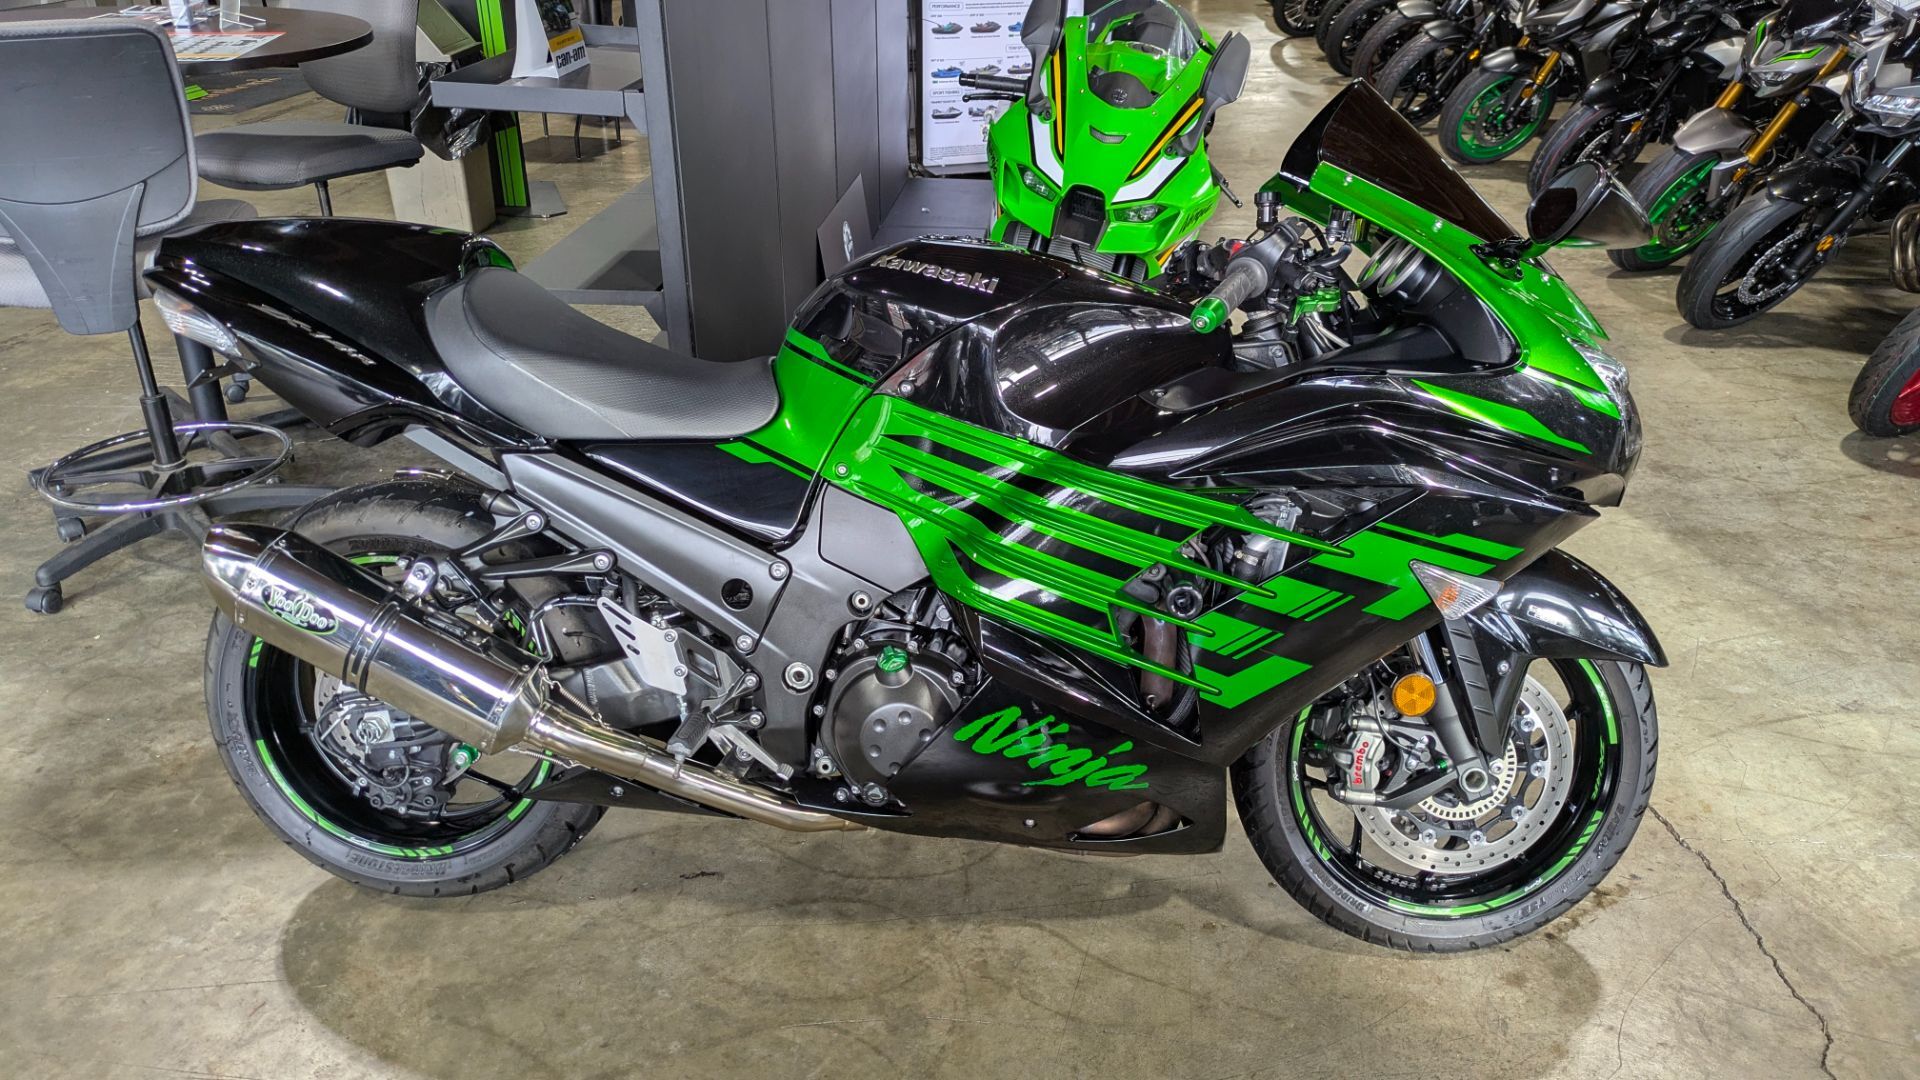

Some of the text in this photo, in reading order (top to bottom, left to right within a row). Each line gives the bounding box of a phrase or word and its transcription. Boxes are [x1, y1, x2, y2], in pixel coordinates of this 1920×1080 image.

[555, 45, 586, 69] can-am
[871, 254, 999, 294] Kawasaki
[953, 706, 1149, 791] Ninja
[1353, 741, 1370, 785] brembo
